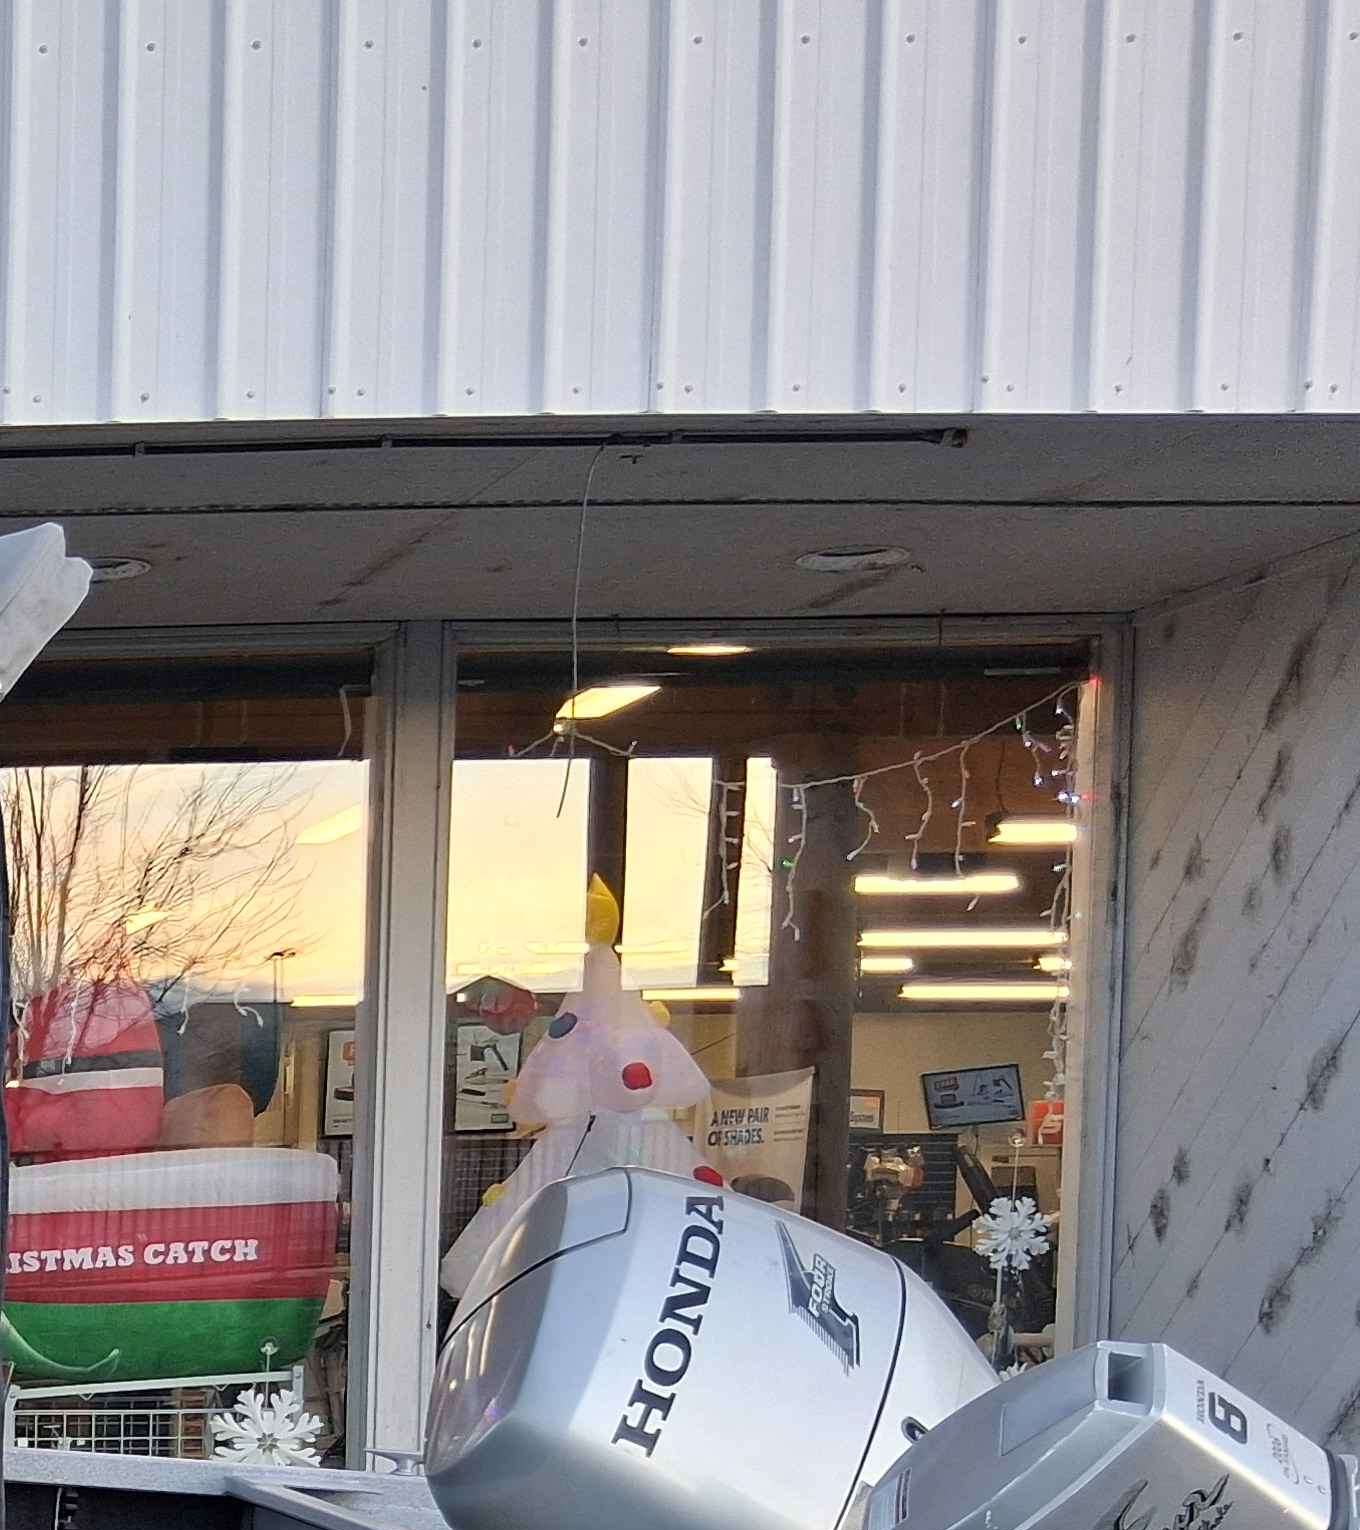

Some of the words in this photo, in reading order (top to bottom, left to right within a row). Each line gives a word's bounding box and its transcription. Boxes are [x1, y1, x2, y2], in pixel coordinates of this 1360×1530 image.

[720, 1109, 745, 1126] NEW
[747, 1107, 769, 1124] PAIR
[708, 1131, 723, 1146] OF
[5, 1245, 134, 1274] ISTMAS
[144, 1239, 259, 1265] CATCH
[808, 1255, 826, 1317] FOUR
[611, 1196, 724, 1457] HONDA
